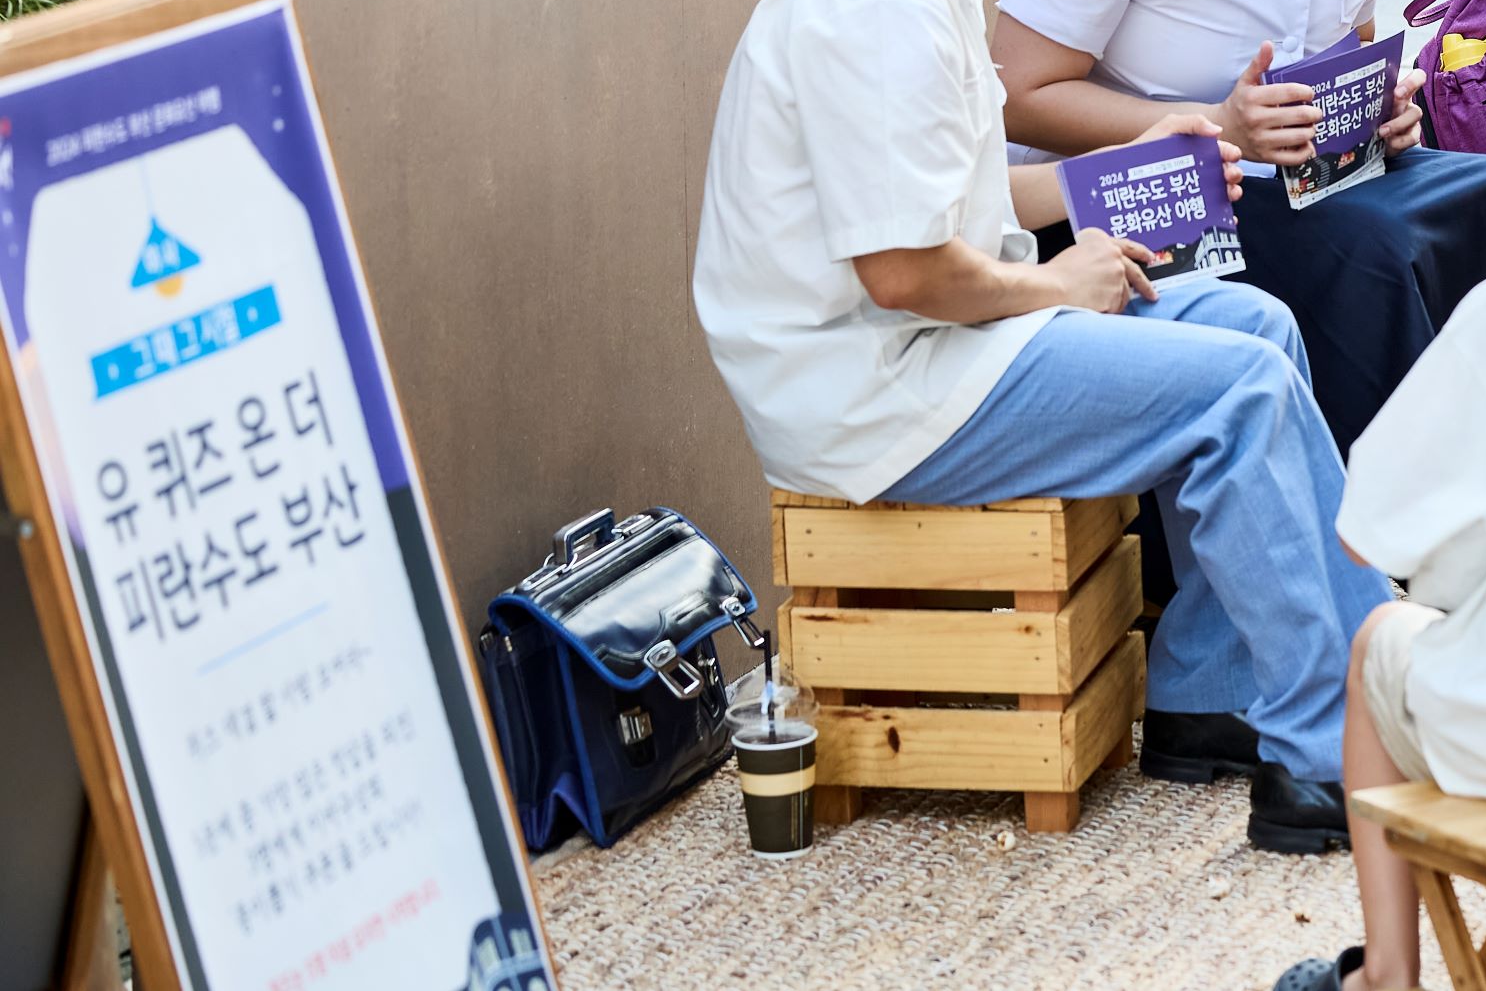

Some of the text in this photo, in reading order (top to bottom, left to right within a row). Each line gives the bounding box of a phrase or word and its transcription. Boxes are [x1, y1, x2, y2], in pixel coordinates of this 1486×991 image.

[1365, 72, 1387, 97] 부산
[1315, 96, 1385, 144] 문화유산 야행
[1099, 172, 1125, 187] 2024
[1102, 169, 1201, 211] 피란수도 부산
[1109, 195, 1208, 239] 문화유산 야행
[97, 368, 334, 544] 유 퀴즈 온 더
[115, 462, 366, 642] 피란수도 부산
